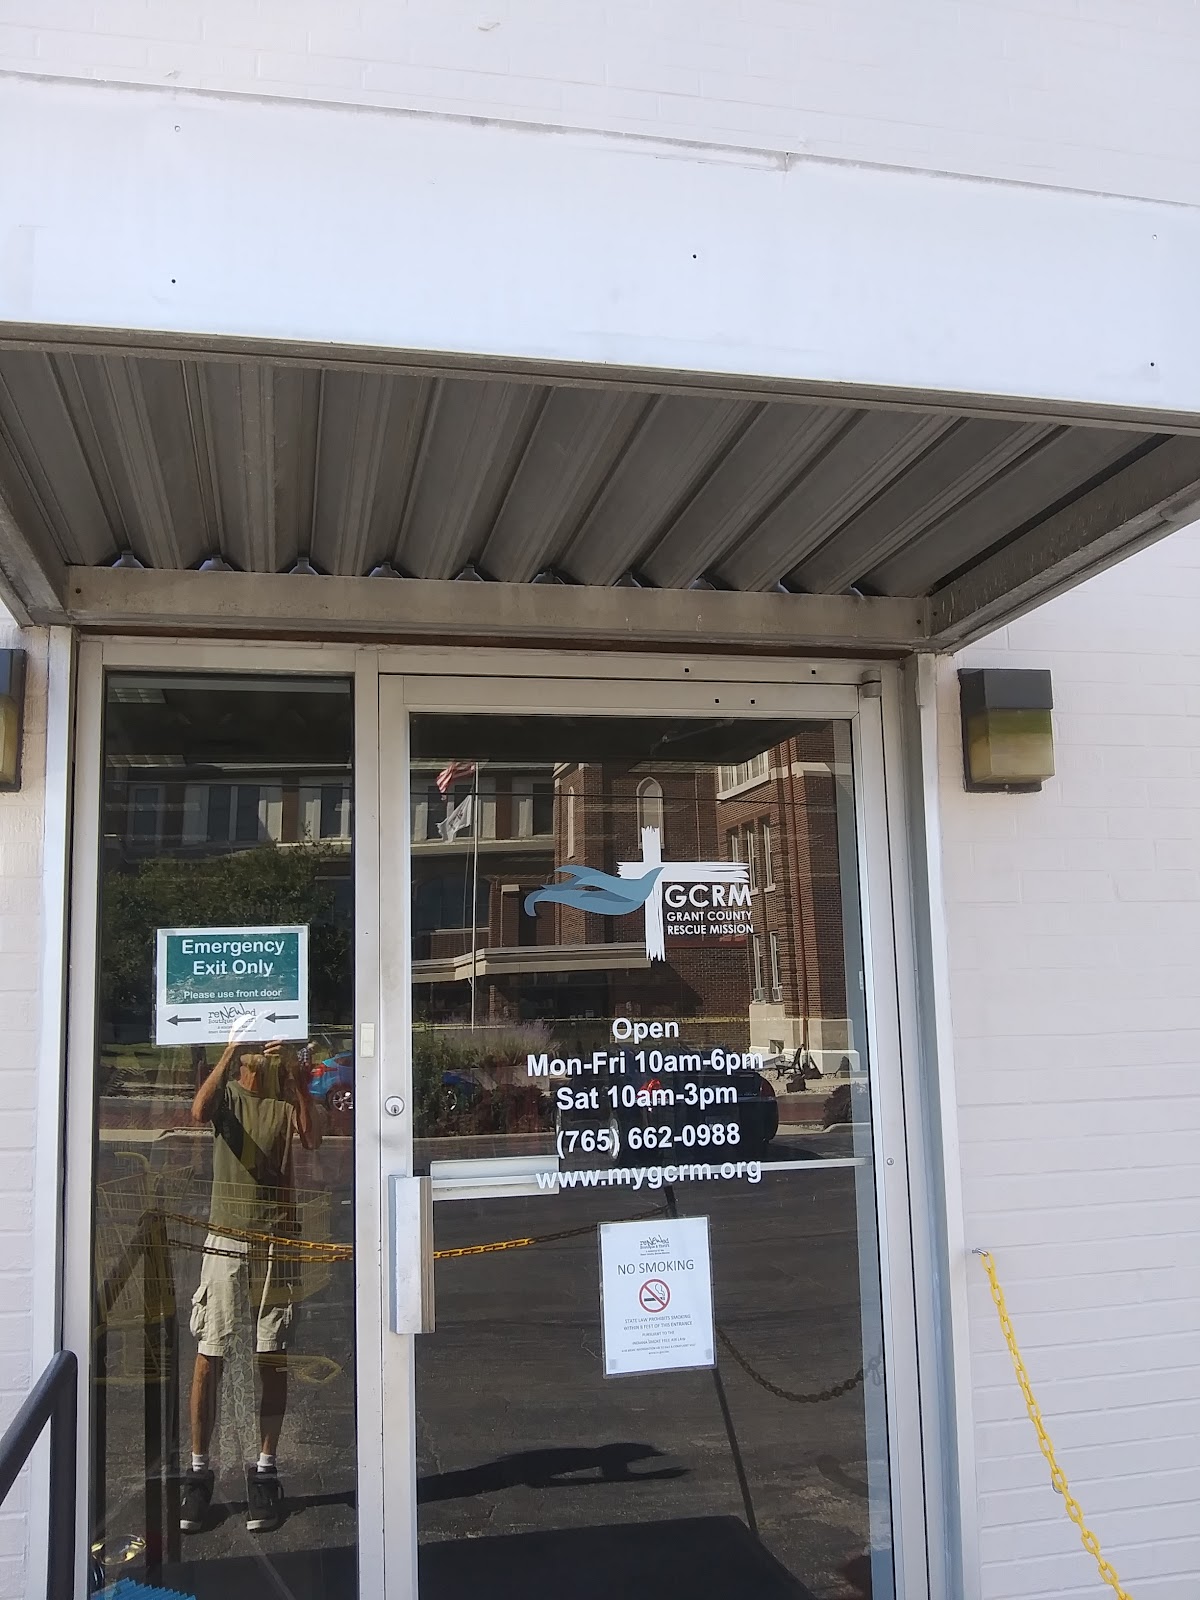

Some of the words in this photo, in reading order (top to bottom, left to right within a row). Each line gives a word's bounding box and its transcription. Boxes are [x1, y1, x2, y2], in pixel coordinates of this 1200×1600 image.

[665, 884, 752, 908] GCRM
[667, 911, 704, 922] GRANT
[707, 910, 752, 921] COUNTY
[667, 925, 707, 935] RESCUE
[709, 924, 754, 934] MISSION
[181, 939, 285, 957] Emergency
[193, 960, 228, 975] Exit
[232, 959, 273, 977] Only
[183, 990, 216, 999] Please
[236, 989, 258, 998] front
[260, 988, 282, 997] door
[612, 1017, 680, 1045] Open
[527, 1050, 626, 1077] Mon-Fri
[634, 1048, 764, 1075] 10am-6pm
[556, 1086, 600, 1110] Sat
[608, 1082, 738, 1110] 10am-3pm
[556, 1127, 621, 1159] (765)
[628, 1122, 741, 1150] 662-0988
[536, 1160, 763, 1190] www.mygcrm.org
[617, 1263, 636, 1275] NO
[639, 1259, 694, 1273] SMOKING
